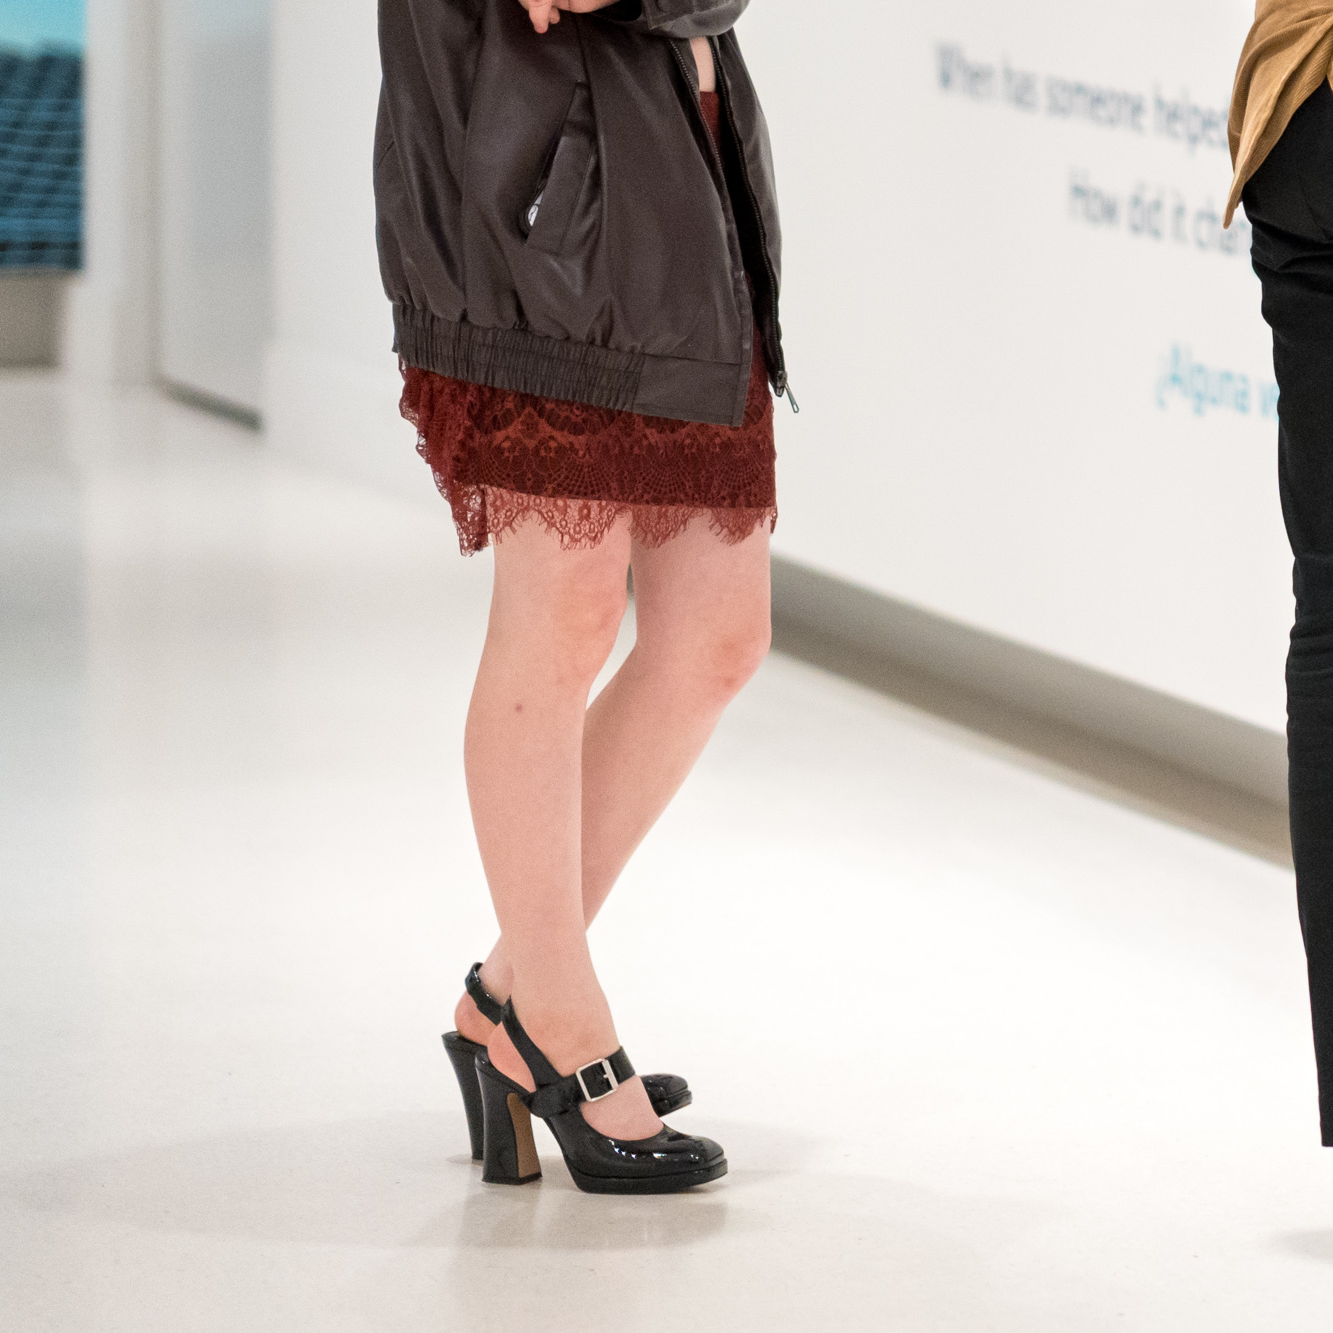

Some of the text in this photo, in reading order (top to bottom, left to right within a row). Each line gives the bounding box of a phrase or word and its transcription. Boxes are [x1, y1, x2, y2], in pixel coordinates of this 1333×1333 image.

[939, 44, 993, 102] When
[1002, 54, 1037, 113] has
[1046, 75, 1146, 134] someone
[1067, 167, 1119, 229] How
[1127, 180, 1164, 239] did
[1170, 188, 1187, 244] it
